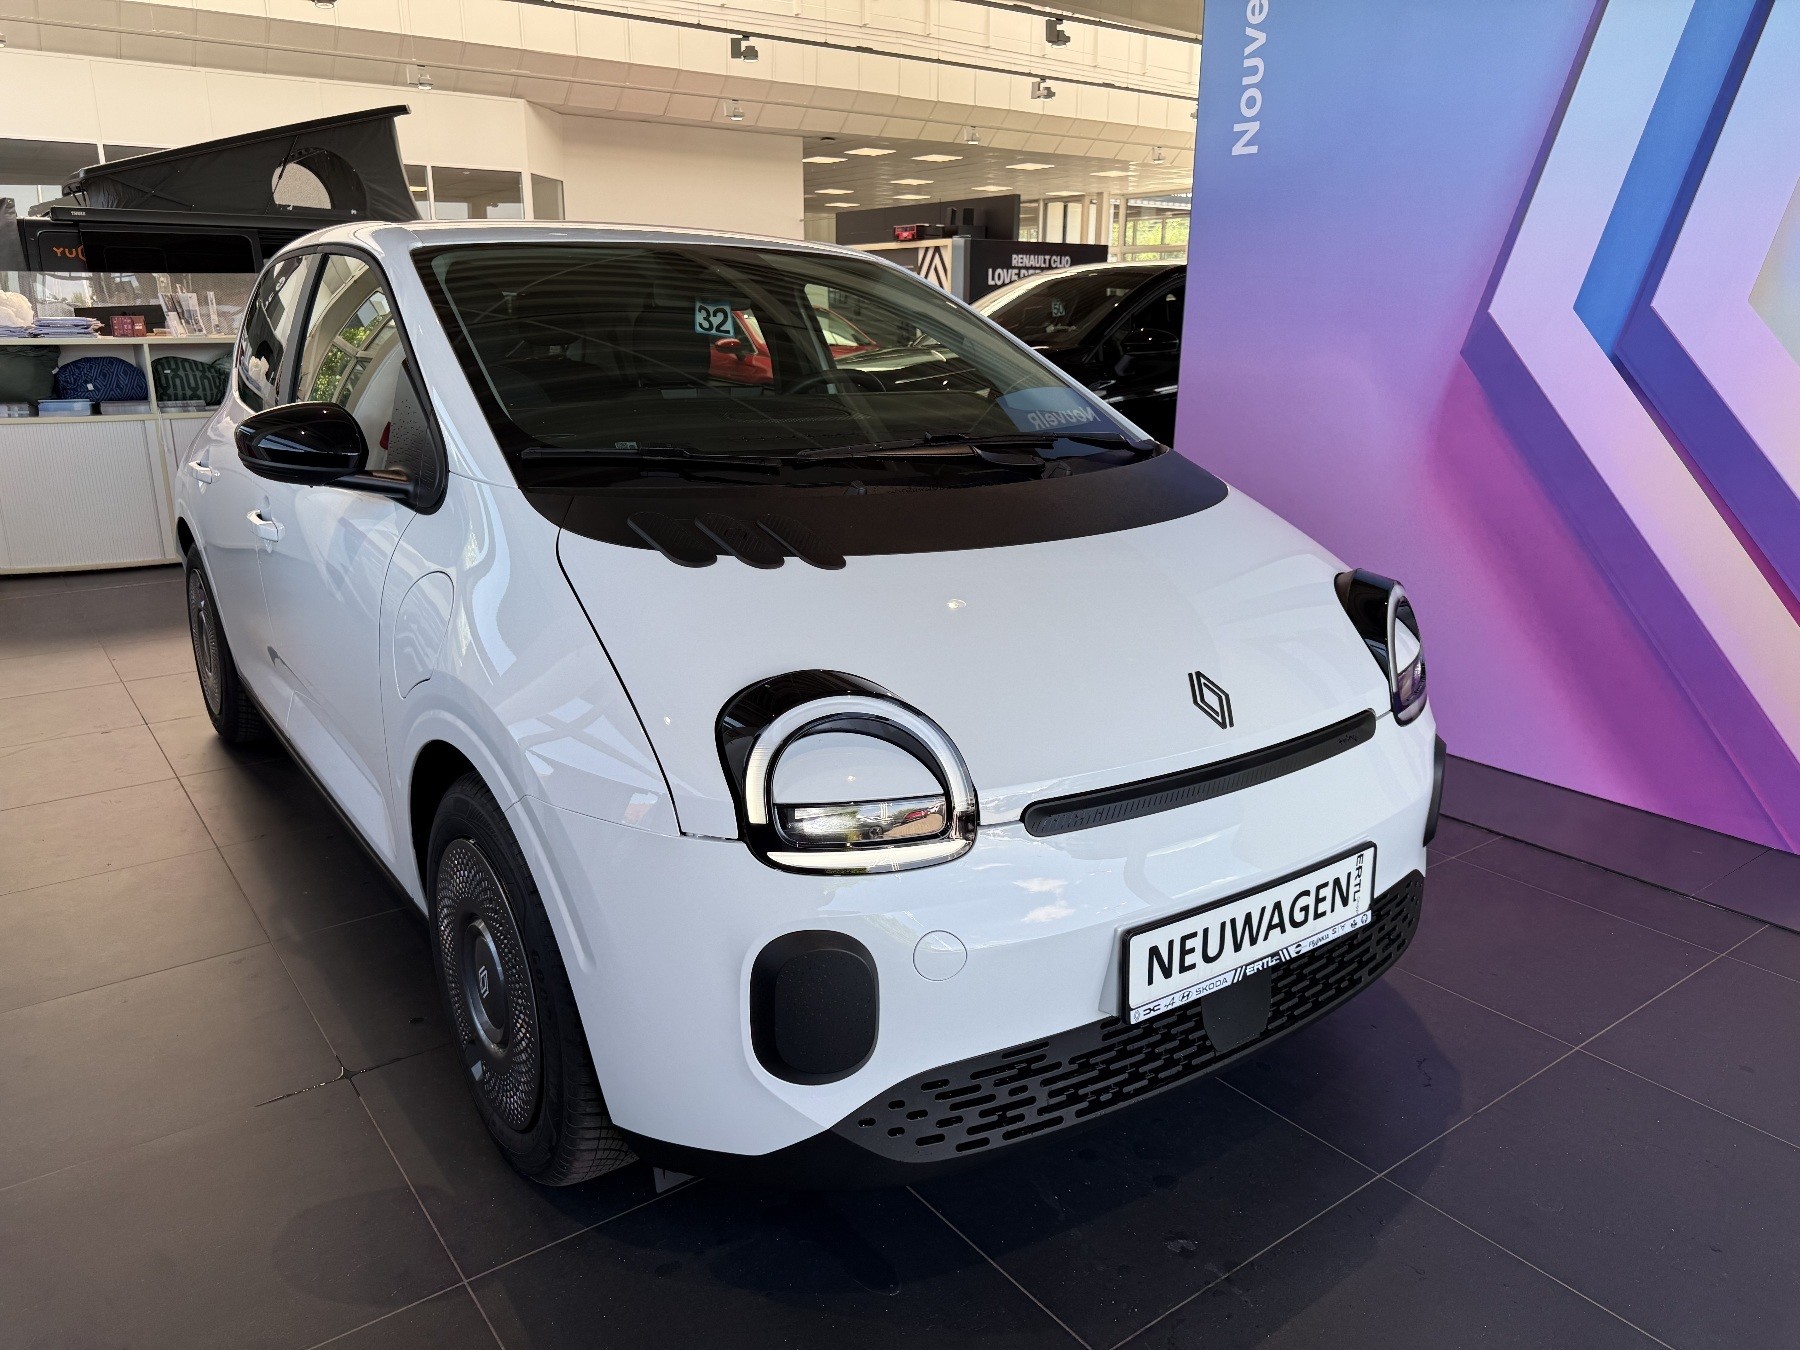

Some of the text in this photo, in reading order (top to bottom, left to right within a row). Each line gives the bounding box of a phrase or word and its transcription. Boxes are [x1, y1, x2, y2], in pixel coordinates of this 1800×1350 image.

[1011, 254, 1071, 268] RENAULT CLIO
[988, 268, 1018, 286] LOVE
[698, 305, 730, 334] 32
[1353, 853, 1364, 902] ERTL
[1147, 871, 1351, 986] NEUWAGEN
